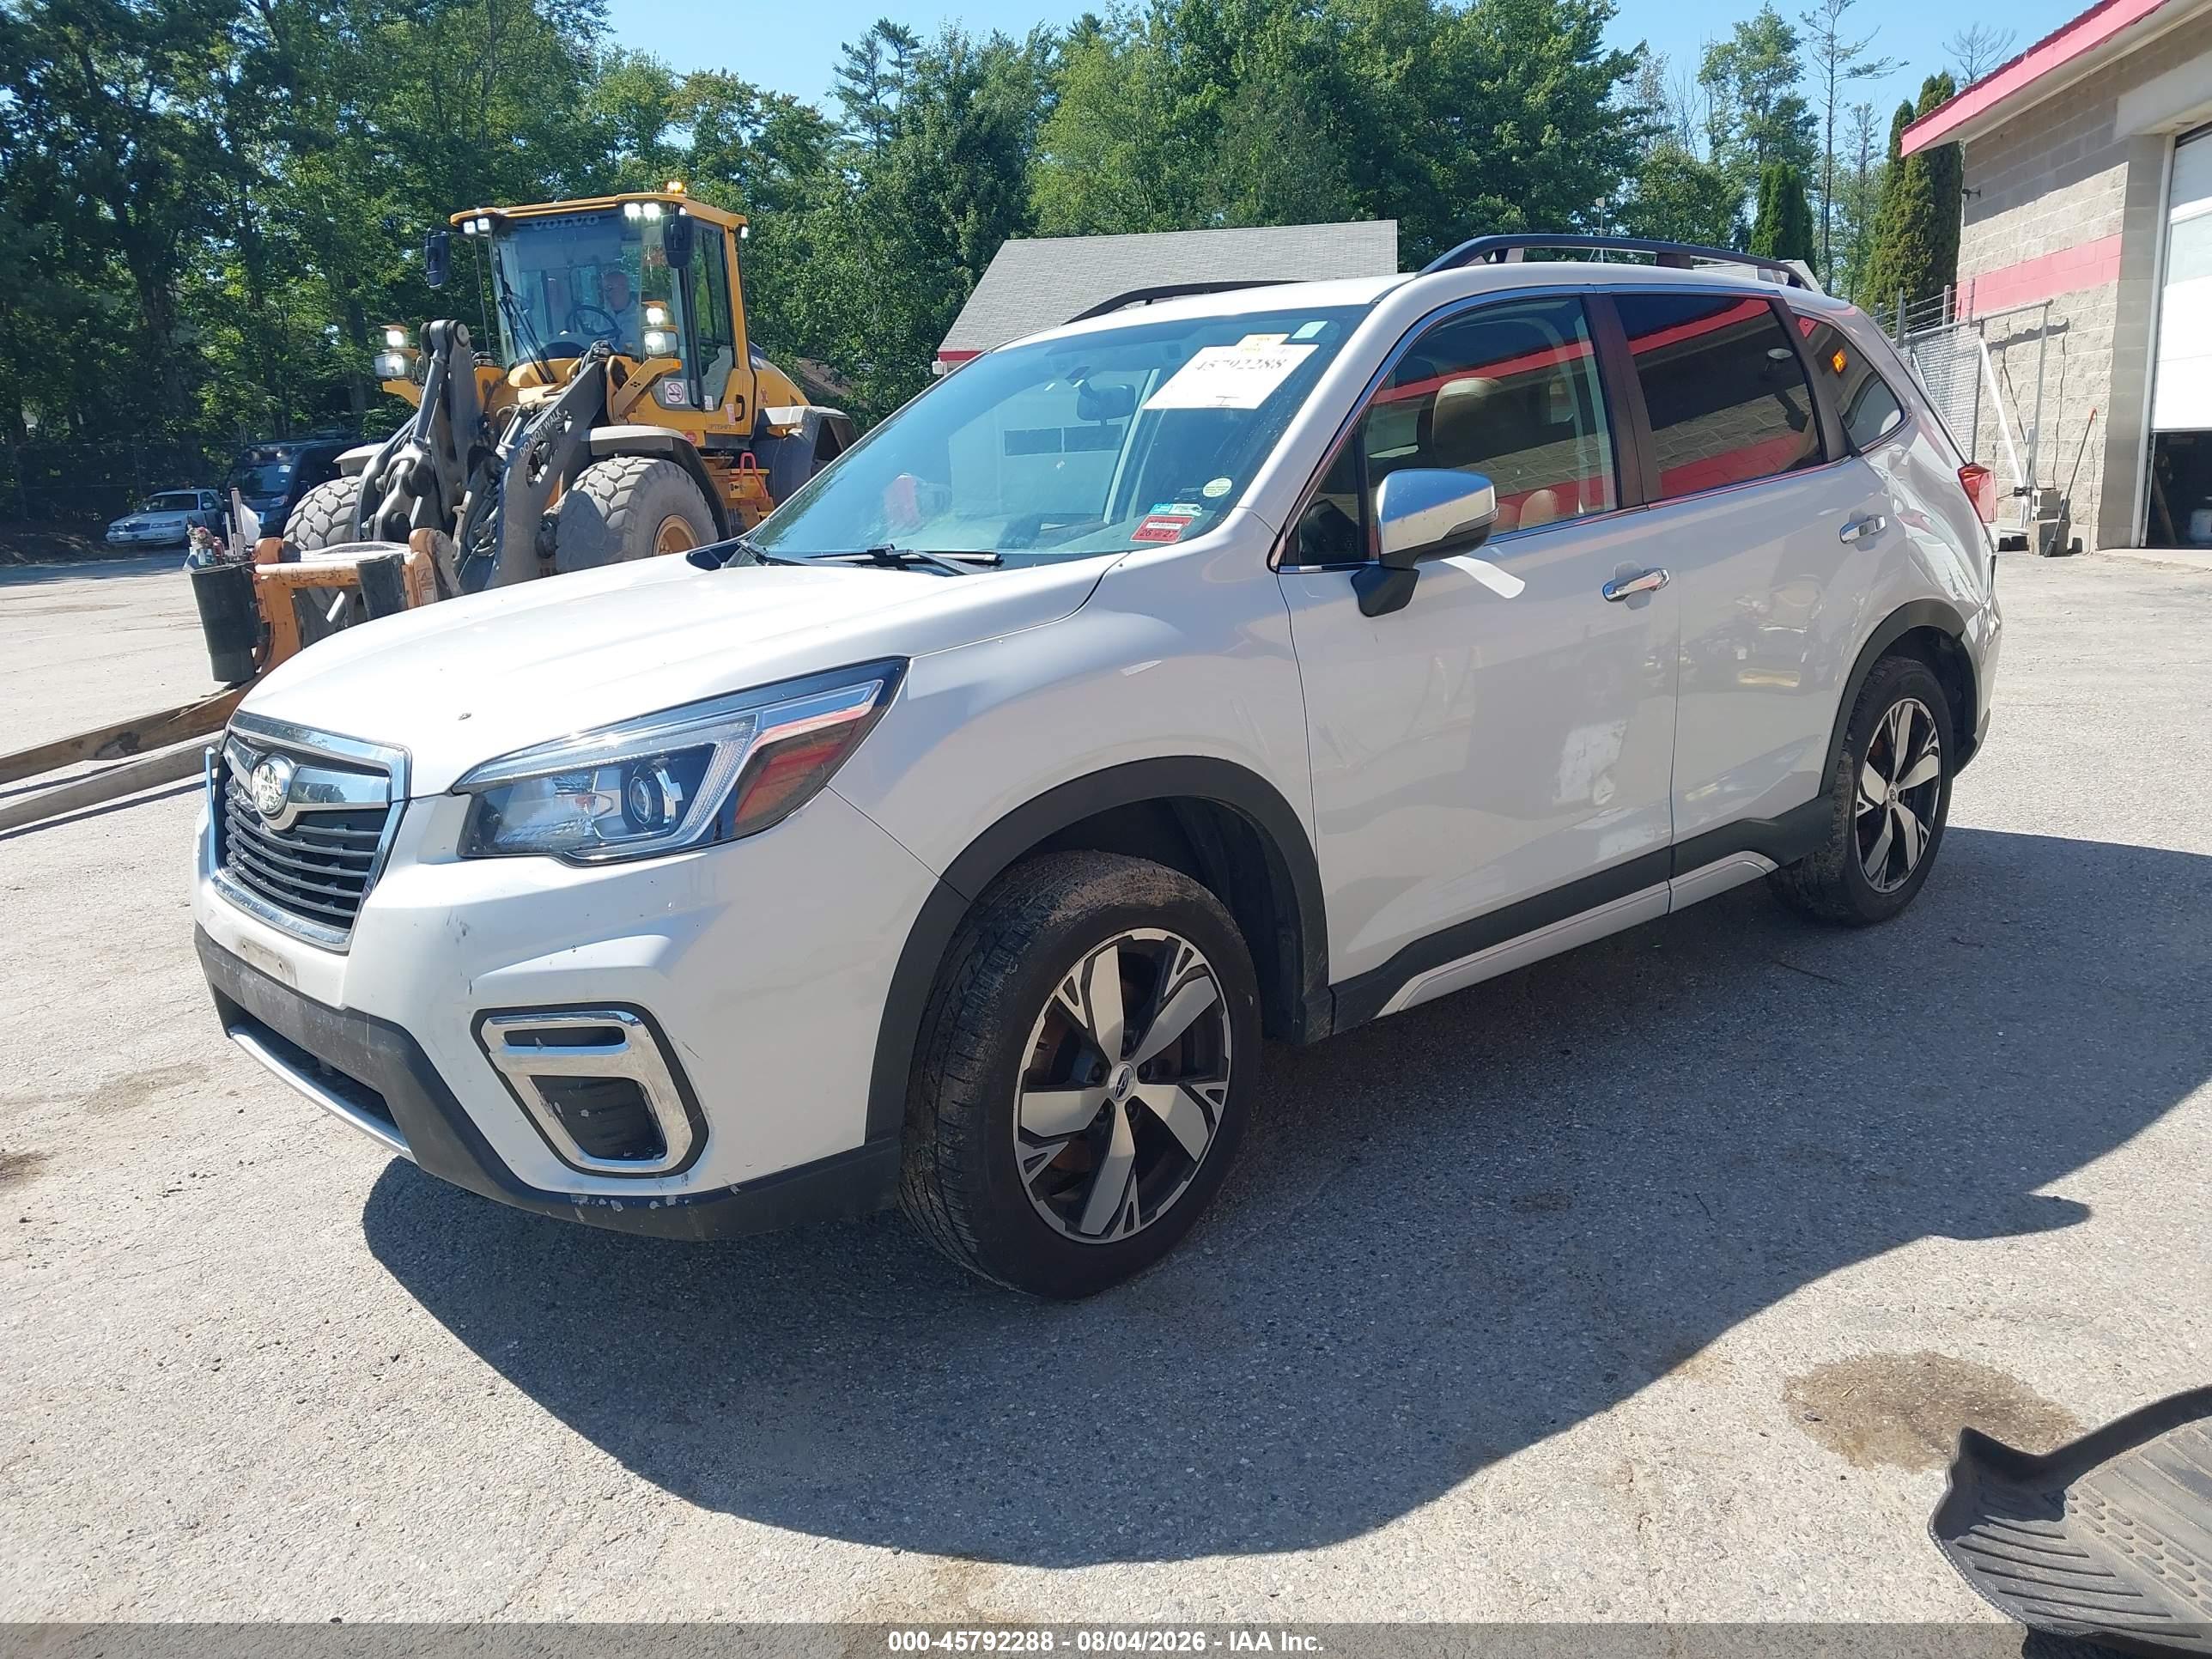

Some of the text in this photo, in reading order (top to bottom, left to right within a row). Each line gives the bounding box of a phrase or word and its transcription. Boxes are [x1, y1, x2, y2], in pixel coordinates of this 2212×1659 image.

[534, 215, 599, 230] VOLVO
[519, 406, 562, 457] DO NOT WALK
